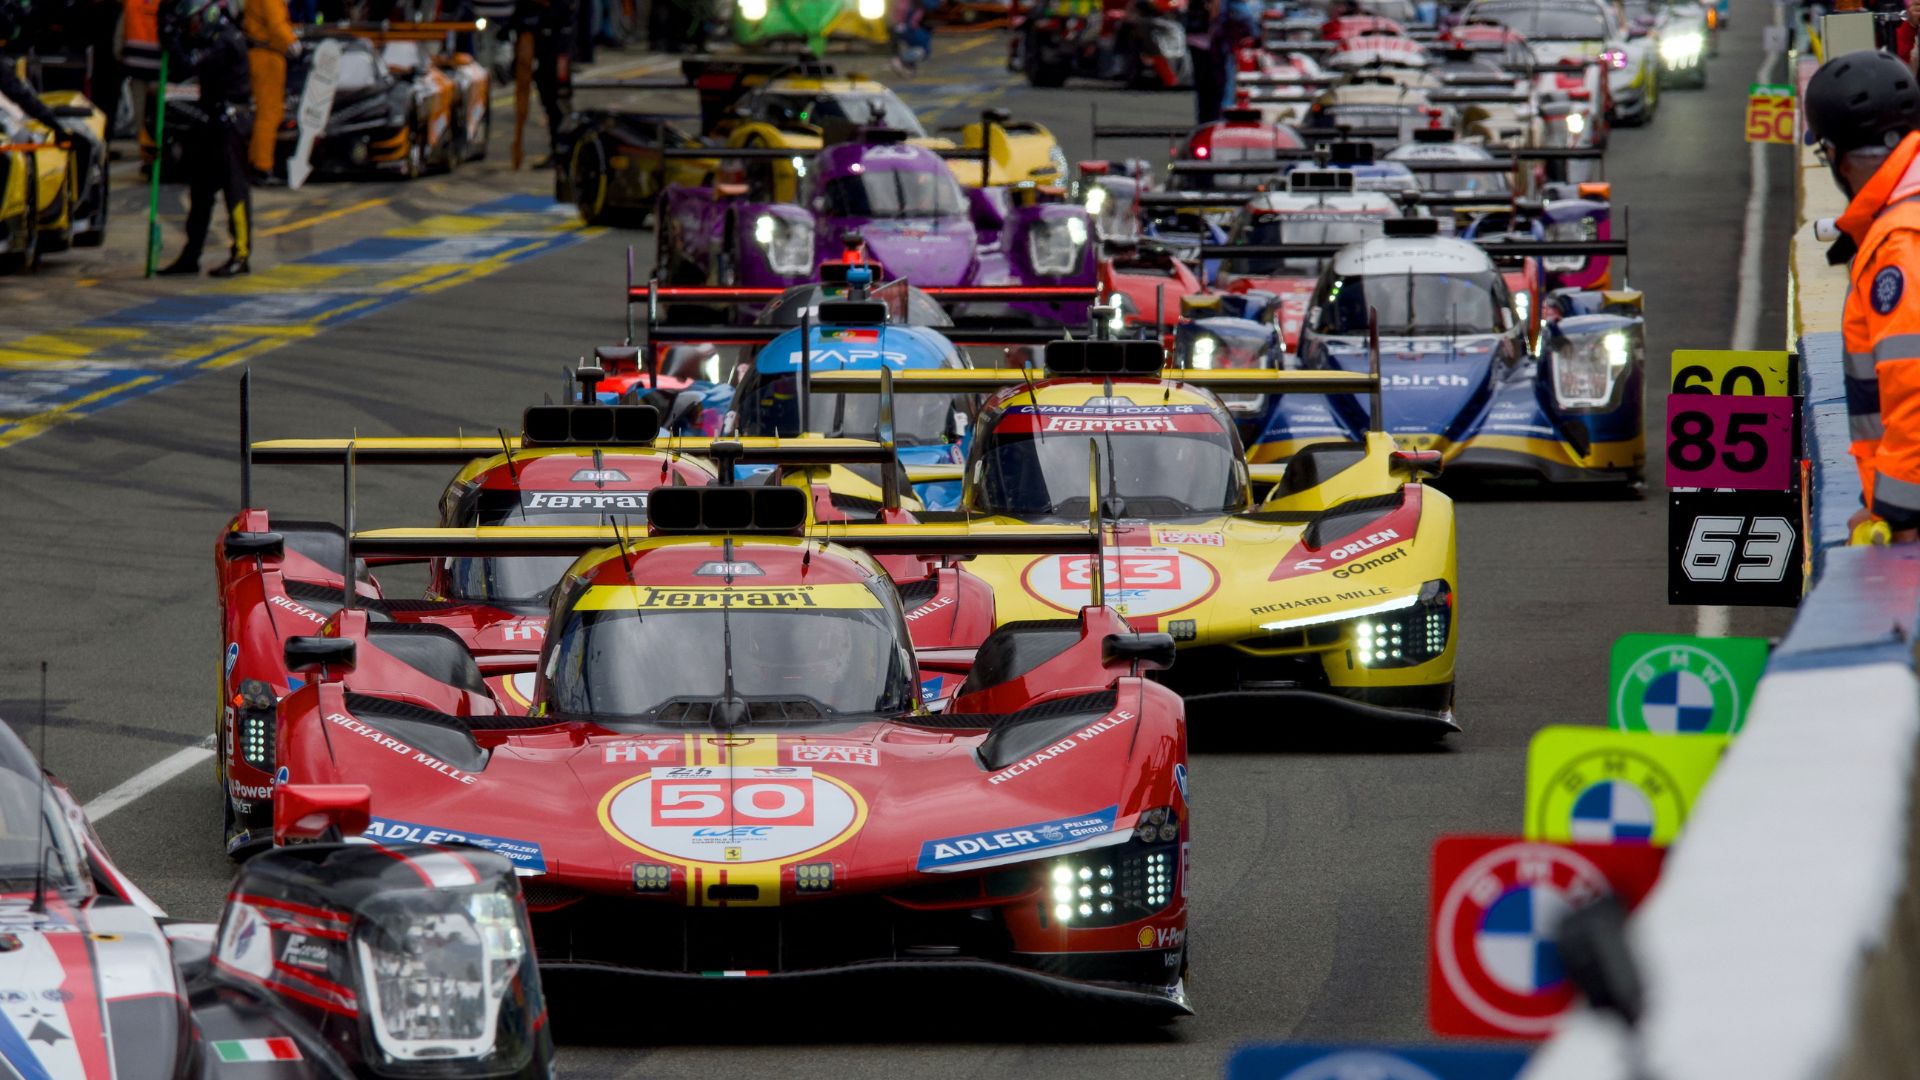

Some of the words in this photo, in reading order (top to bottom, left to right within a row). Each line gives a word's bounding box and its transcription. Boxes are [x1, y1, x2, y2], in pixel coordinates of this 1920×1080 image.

[1749, 111, 1794, 140] 50
[1020, 405, 1107, 414] CHARLES
[1112, 405, 1170, 414] POZZI
[1043, 416, 1178, 432] Ferrari
[1668, 411, 1768, 473] 85
[1163, 536, 1219, 545] CAR
[1330, 528, 1399, 561] ORLEN
[1681, 516, 1796, 582] 63
[1066, 559, 1175, 584] 83
[1332, 547, 1408, 579] GOmart
[270, 595, 327, 626] RICHAR
[638, 586, 817, 608] Ferrari
[905, 597, 954, 622] MILLE
[1250, 595, 1332, 615] RICHARD
[1335, 586, 1392, 601] MILLE
[1634, 651, 1722, 685] BMW
[326, 713, 412, 757] RICHARD
[412, 753, 478, 784] MILLE
[606, 745, 669, 762] HY
[797, 752, 872, 764] CAR
[988, 739, 1077, 785] RICHARD
[1080, 710, 1135, 741] MILLE
[1564, 759, 1661, 795] BMW
[659, 783, 806, 818] 50
[934, 830, 1040, 859] ADLER
